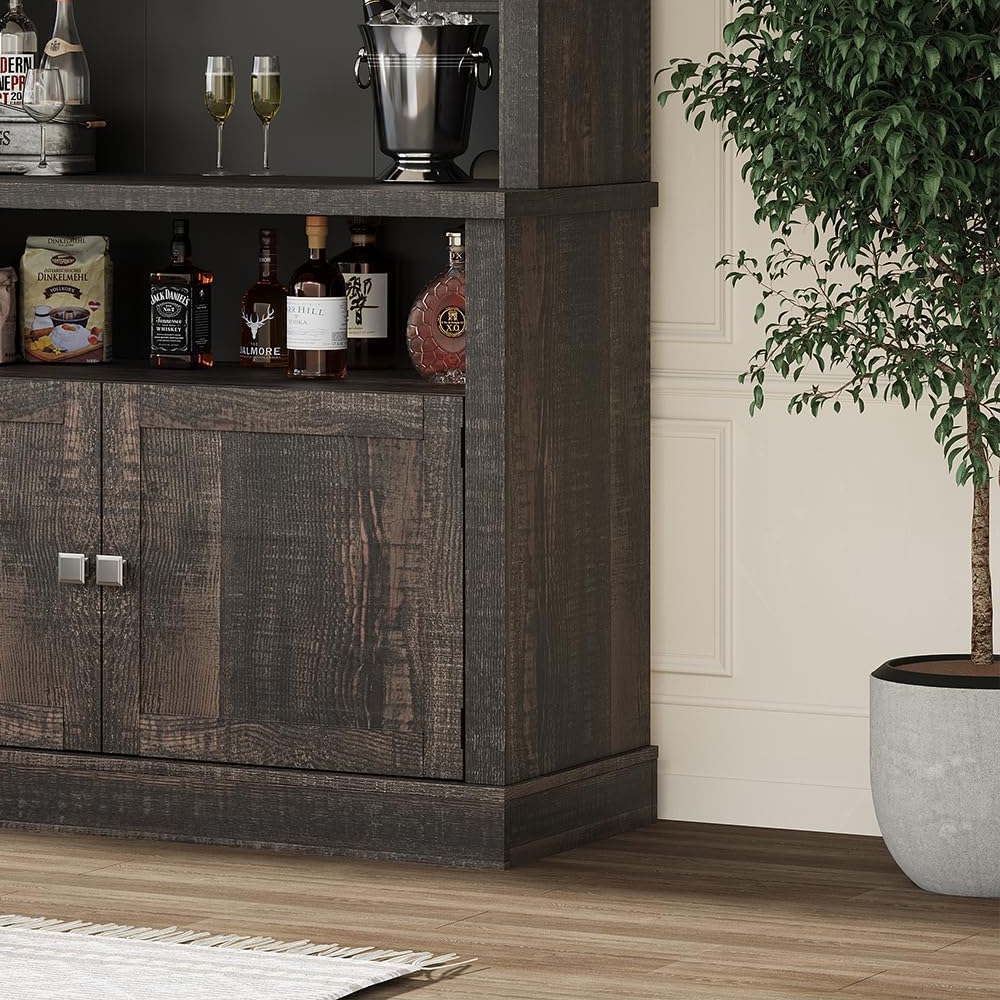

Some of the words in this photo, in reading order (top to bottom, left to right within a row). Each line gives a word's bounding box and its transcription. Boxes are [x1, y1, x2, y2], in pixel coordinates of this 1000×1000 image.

[48, 237, 86, 245] DINKELMEHL
[37, 272, 89, 281] DINKELMEHL
[150, 291, 165, 306] JACK
[165, 288, 191, 307] DANIEL'S
[297, 306, 325, 316] HILL
